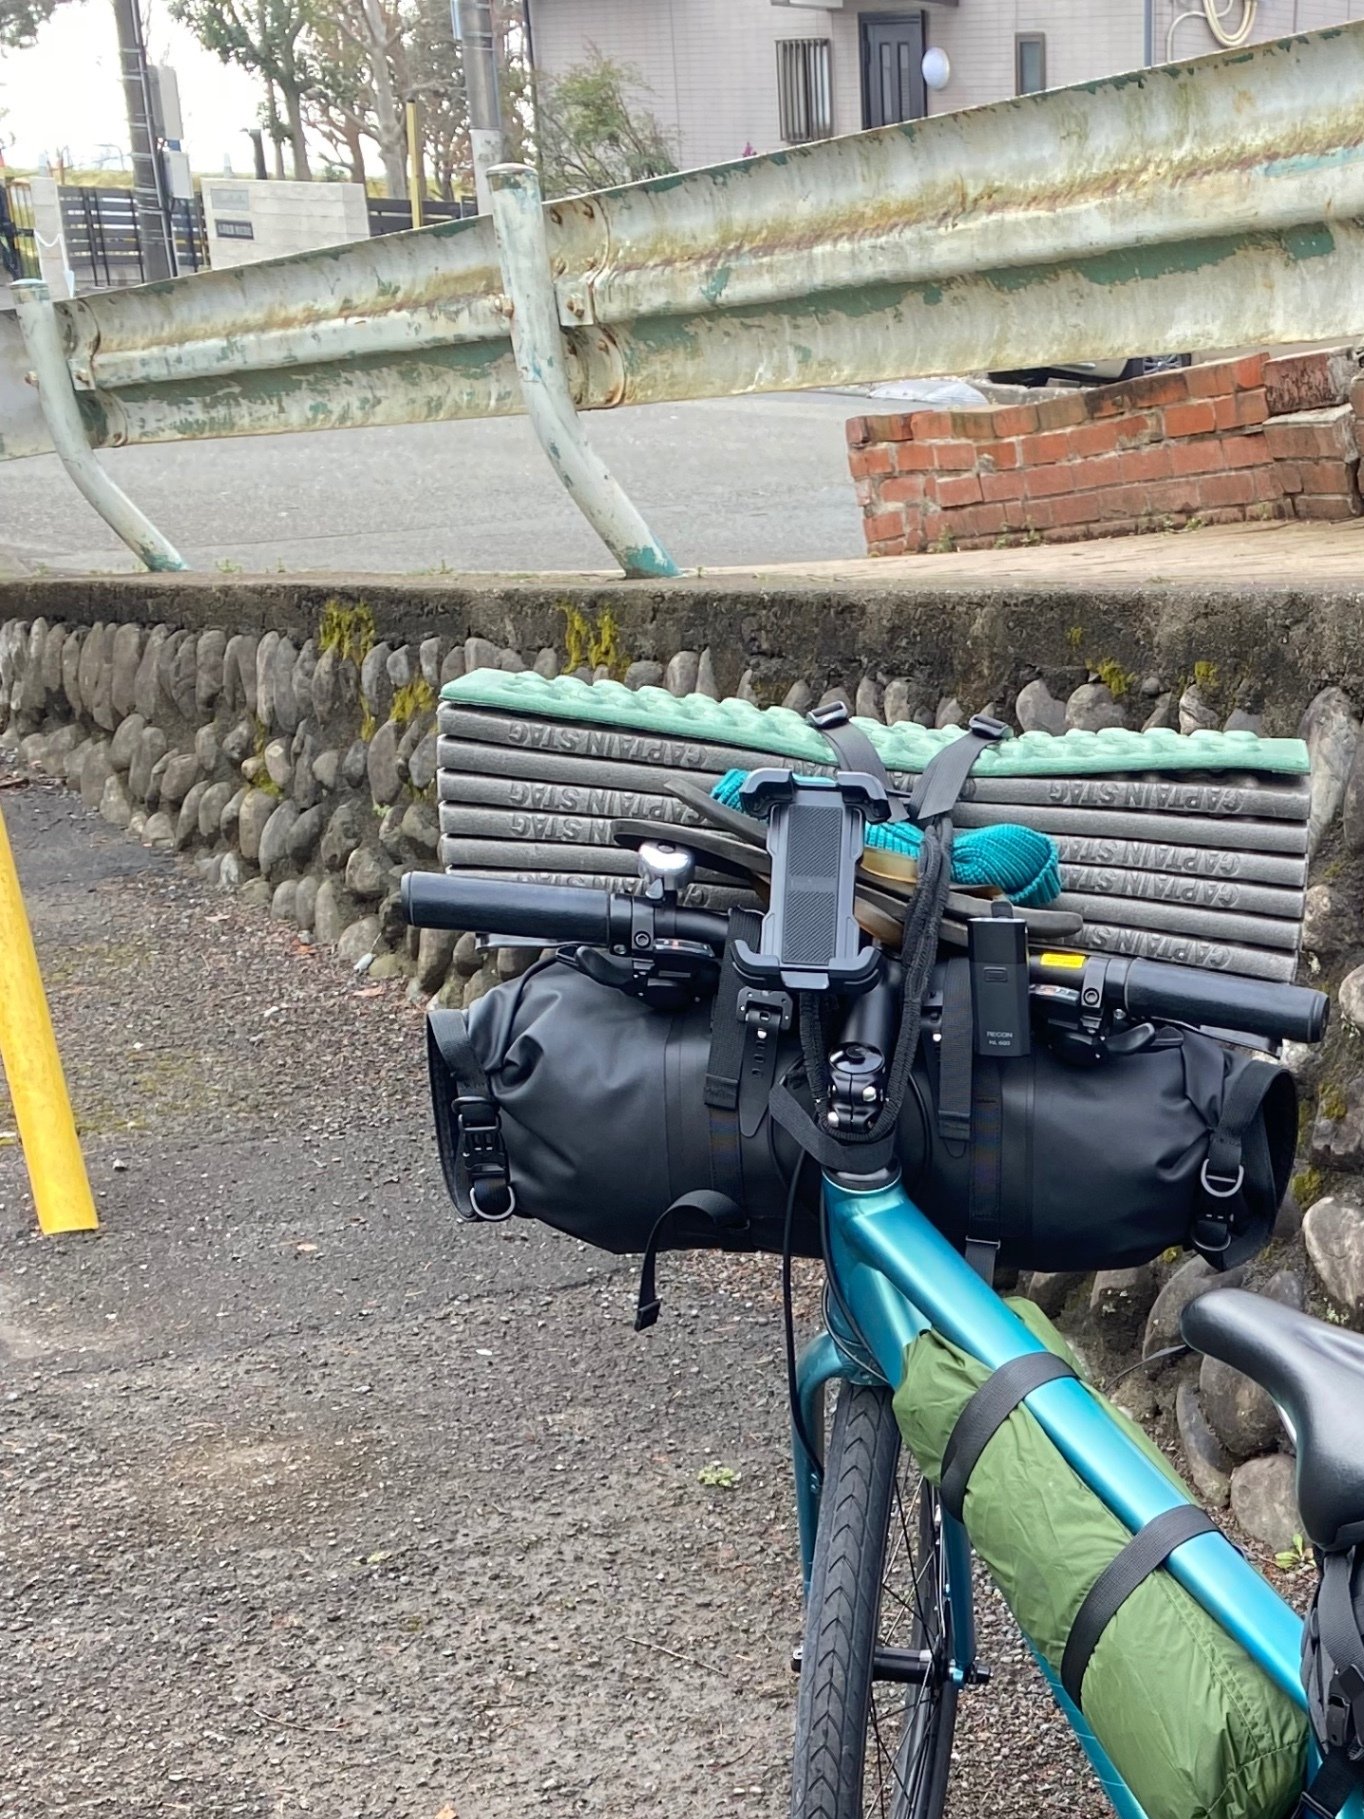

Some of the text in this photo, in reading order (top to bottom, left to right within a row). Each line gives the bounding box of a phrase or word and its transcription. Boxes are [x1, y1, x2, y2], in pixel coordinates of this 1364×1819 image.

[508, 722, 708, 768] CAPTAIN STAG
[508, 782, 582, 812] STAG
[1049, 780, 1244, 812] CAPTAIN STAG
[510, 814, 583, 843] STAG
[1122, 841, 1240, 876] CAPTAIN
[1121, 870, 1239, 907] CAPTAIN
[1115, 930, 1232, 969] CAPTAIN
